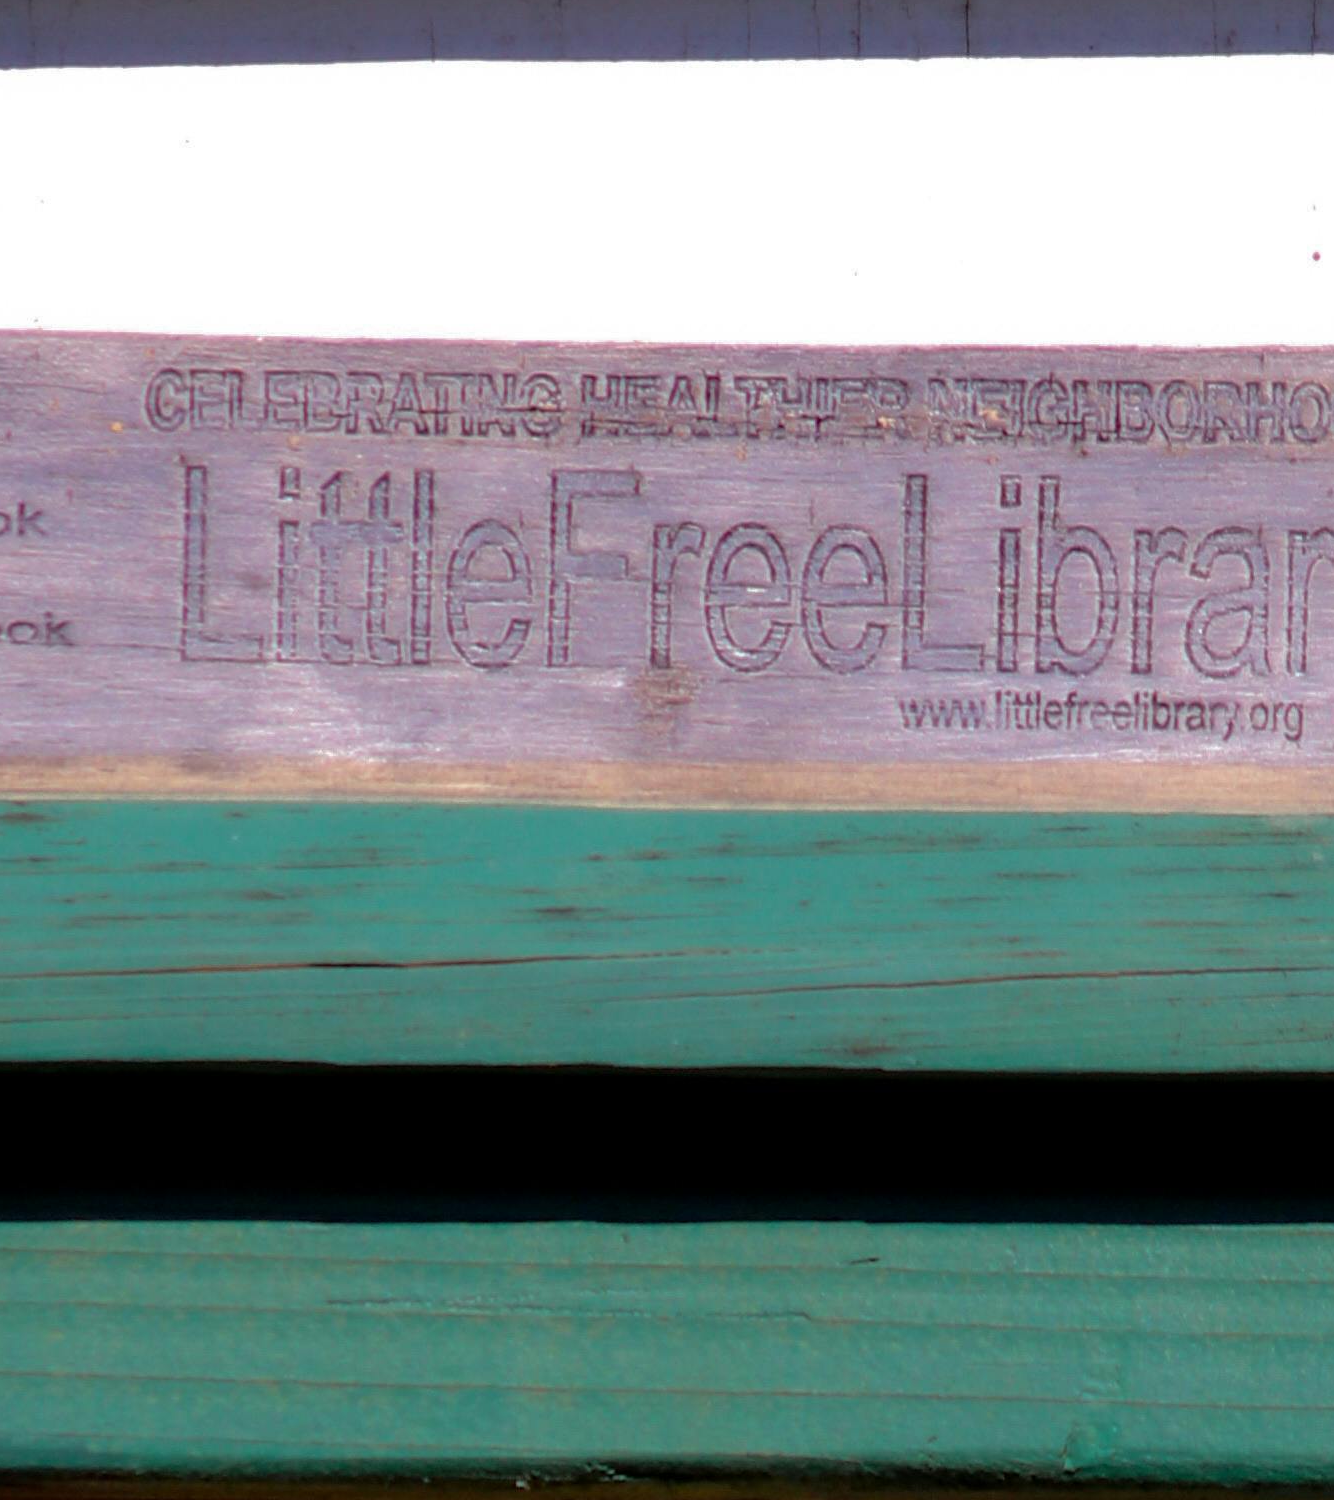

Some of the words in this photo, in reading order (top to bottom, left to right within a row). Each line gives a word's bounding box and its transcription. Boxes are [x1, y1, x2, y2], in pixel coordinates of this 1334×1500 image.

[144, 366, 564, 438] CELEBRATING
[580, 372, 910, 443] HEALTHIER
[897, 690, 1306, 743] www.littlefreelibrary.org
